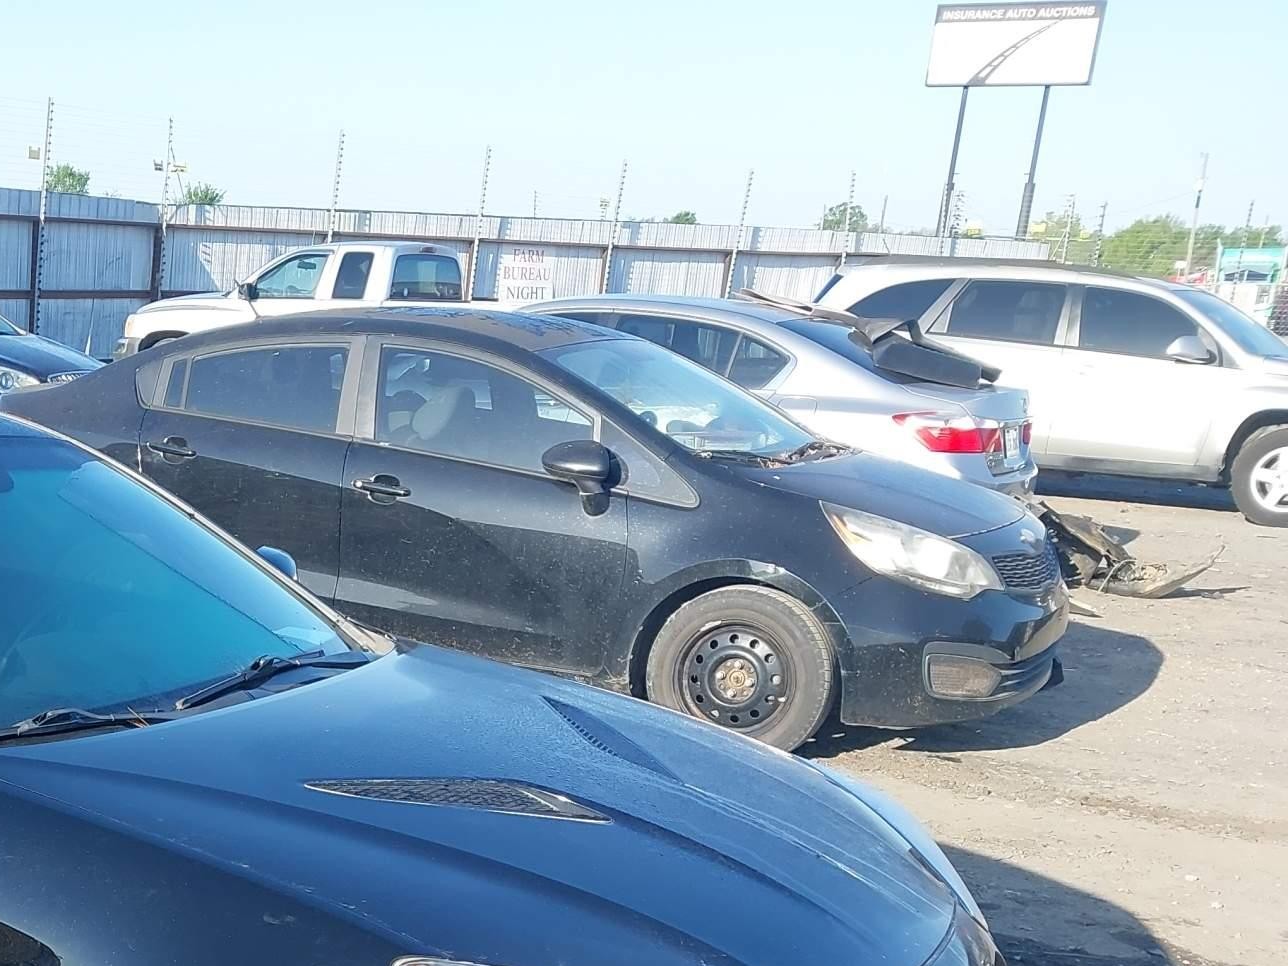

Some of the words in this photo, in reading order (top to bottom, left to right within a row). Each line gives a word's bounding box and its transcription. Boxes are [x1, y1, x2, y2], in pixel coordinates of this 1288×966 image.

[942, 9, 1005, 20] INSURANCE
[1006, 8, 1037, 19] AUTO
[1037, 6, 1096, 17] AUCTIONS
[512, 248, 545, 263] FARM
[503, 266, 551, 280] BUREAU
[506, 286, 546, 299] NIGHT
